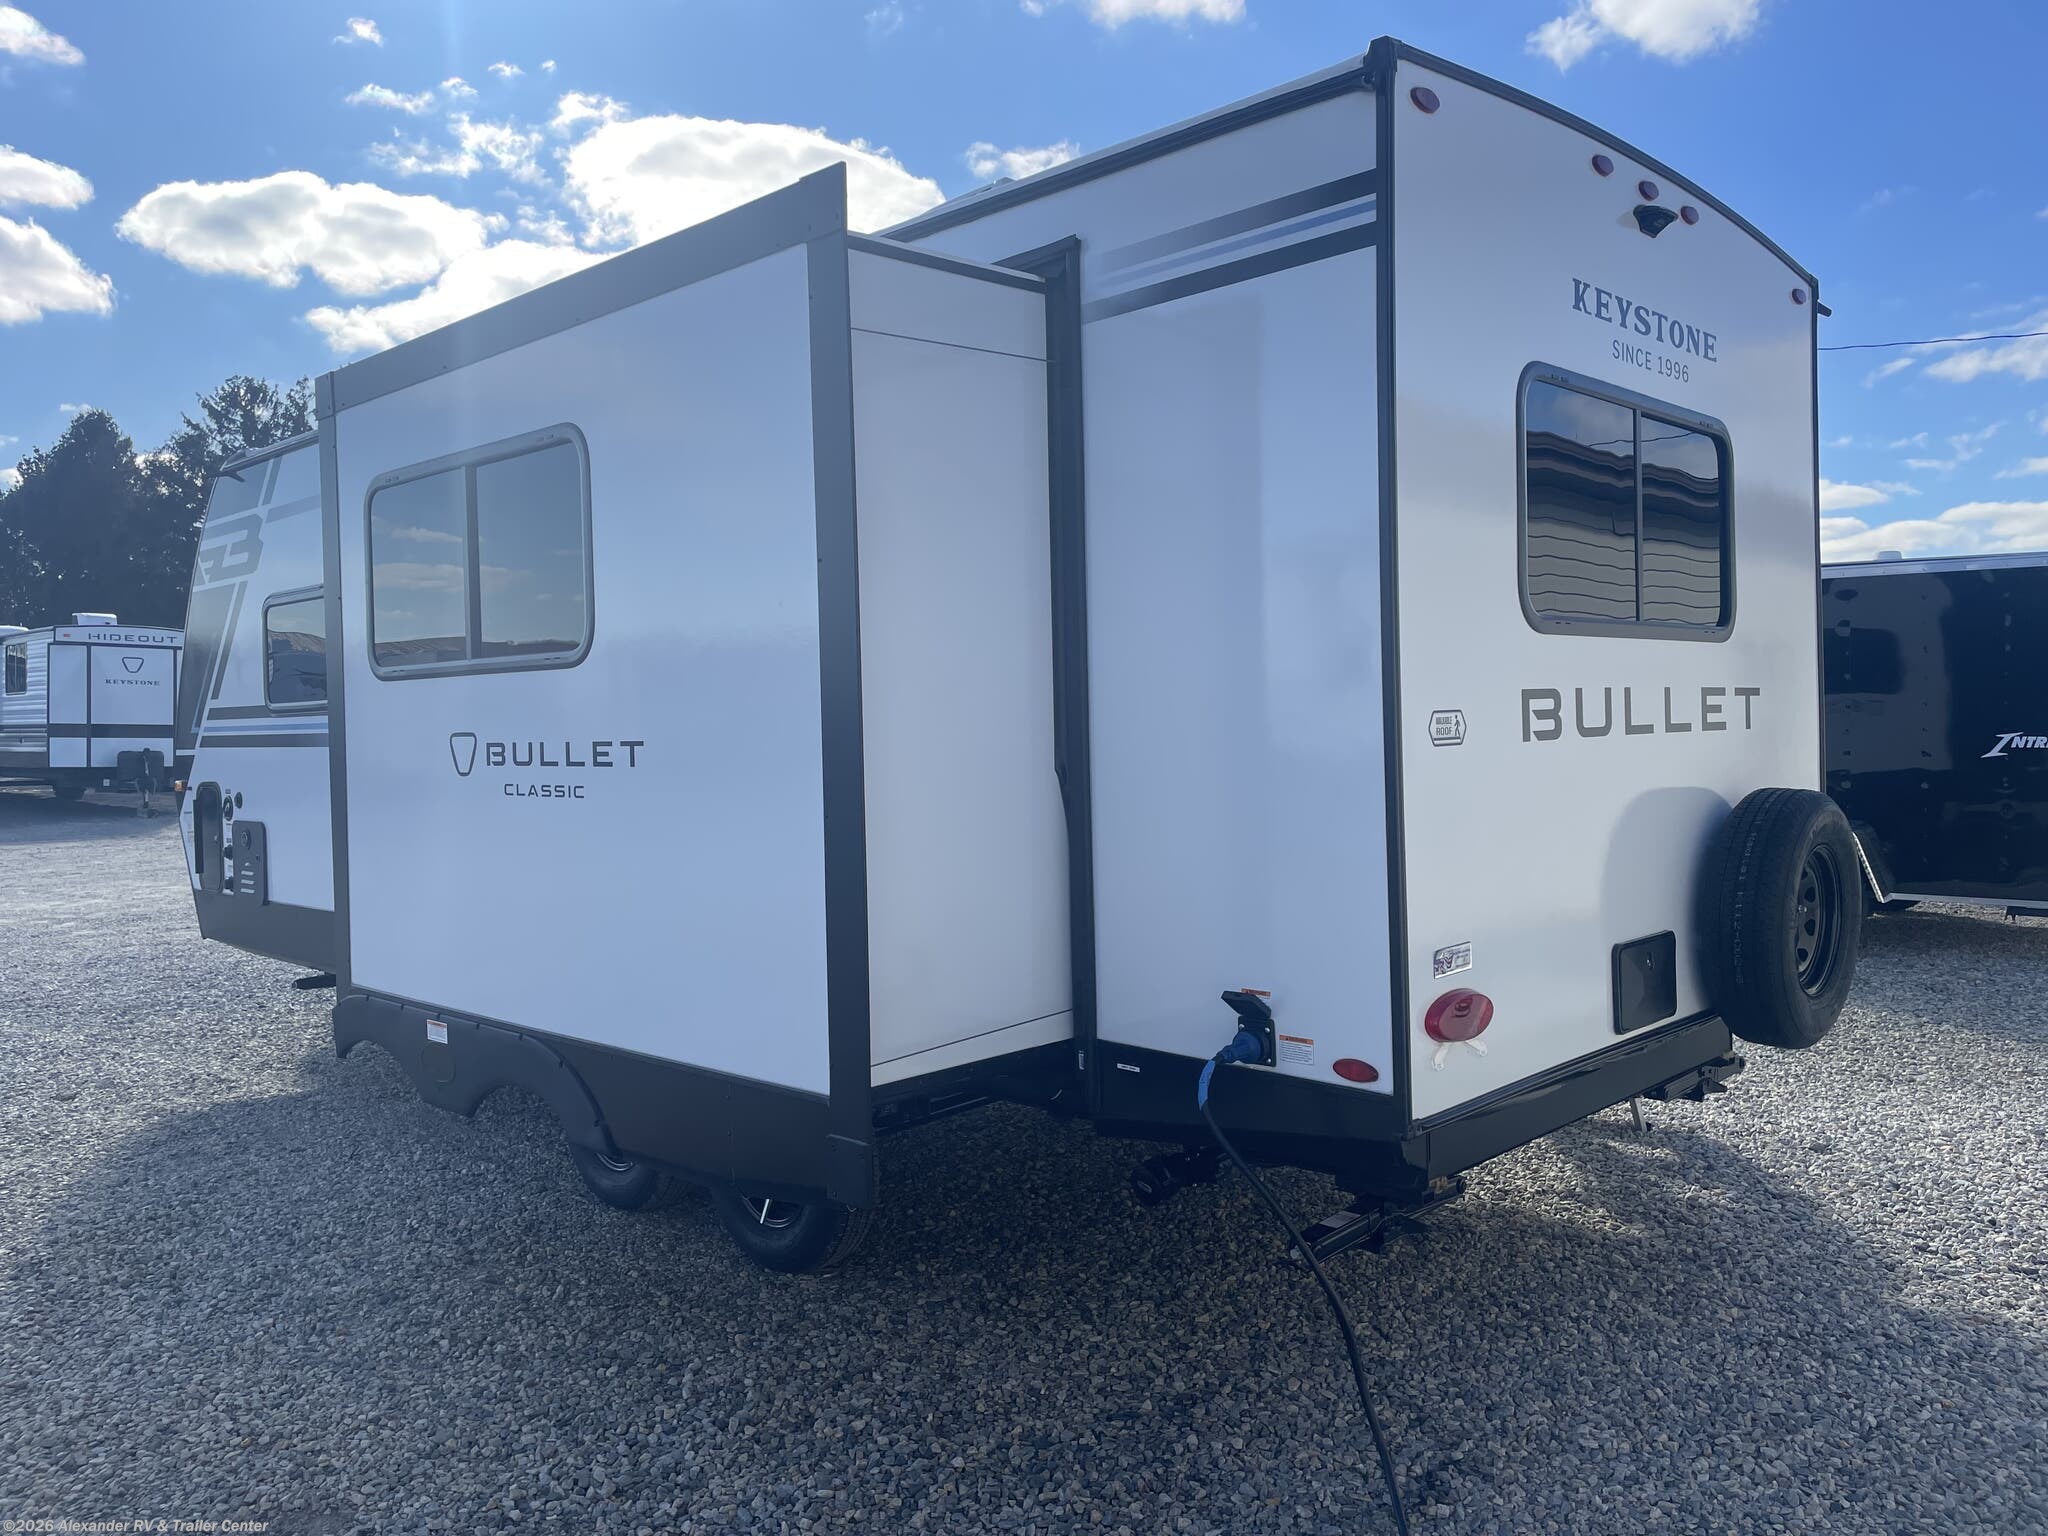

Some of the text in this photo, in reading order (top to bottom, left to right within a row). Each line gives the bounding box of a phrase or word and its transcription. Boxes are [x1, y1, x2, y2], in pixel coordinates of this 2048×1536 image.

[1572, 277, 1717, 363] KEYSTONE
[1612, 339, 1689, 383] SINCE 1996
[88, 632, 178, 643] HIDEOUT
[104, 679, 161, 687] KEYSTONE
[1521, 687, 1761, 742] BULLET
[486, 741, 644, 767] BULLET
[1980, 731, 2048, 758] INTR
[504, 784, 585, 798] CLASSIC
